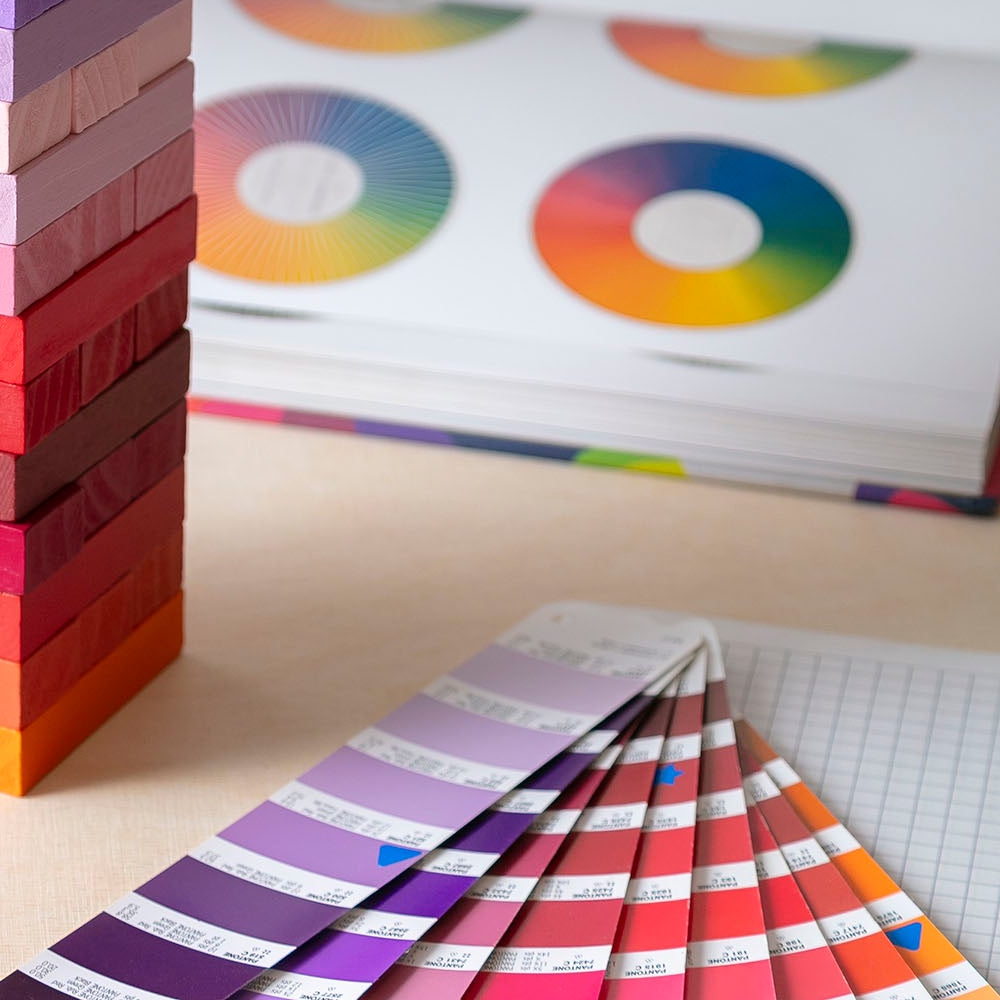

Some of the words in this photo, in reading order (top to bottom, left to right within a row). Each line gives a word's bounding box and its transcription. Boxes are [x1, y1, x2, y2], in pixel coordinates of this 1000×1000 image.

[306, 893, 342, 904] PANTONE
[572, 892, 613, 900] PANTONE
[632, 894, 673, 902] PANTONE
[366, 929, 404, 938] PANTONE
[768, 943, 806, 954] PANTON
[223, 952, 259, 964] PANTONE
[707, 955, 749, 964] PANTONE
[625, 968, 667, 976] PANTONE
[90, 983, 121, 997] PANTONE
